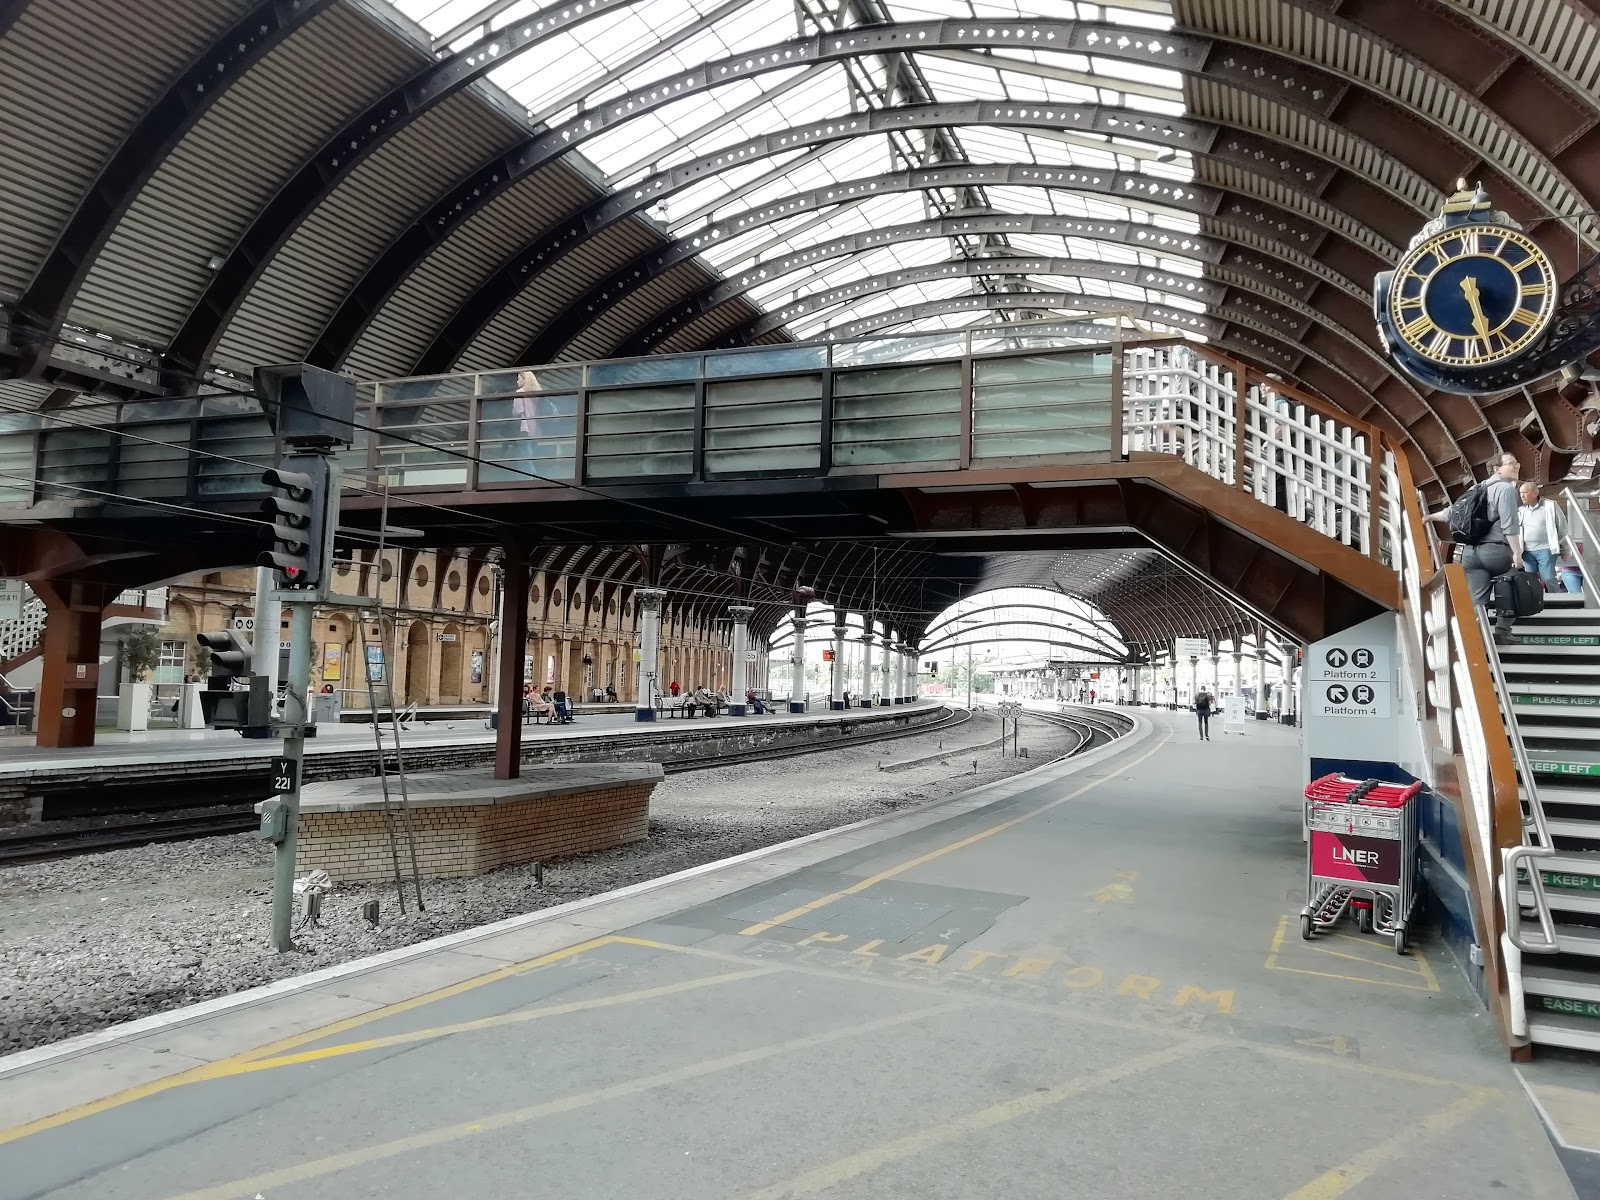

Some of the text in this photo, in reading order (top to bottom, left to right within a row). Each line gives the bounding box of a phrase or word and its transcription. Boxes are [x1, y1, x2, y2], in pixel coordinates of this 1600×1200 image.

[1460, 233, 1479, 255] XII
[1573, 637, 1595, 645] LEFT
[1324, 670, 1377, 679] Platform 2
[1532, 696, 1568, 704] PLEASE
[1570, 697, 1596, 705] KEEP
[1324, 706, 1377, 715] Platform 4
[280, 761, 288, 774] Y
[1561, 764, 1592, 774] LEFT
[274, 776, 291, 790] 221
[1332, 846, 1379, 865] LNER
[1553, 875, 1589, 887] KEEP
[797, 931, 1237, 1016] PLATFORM
